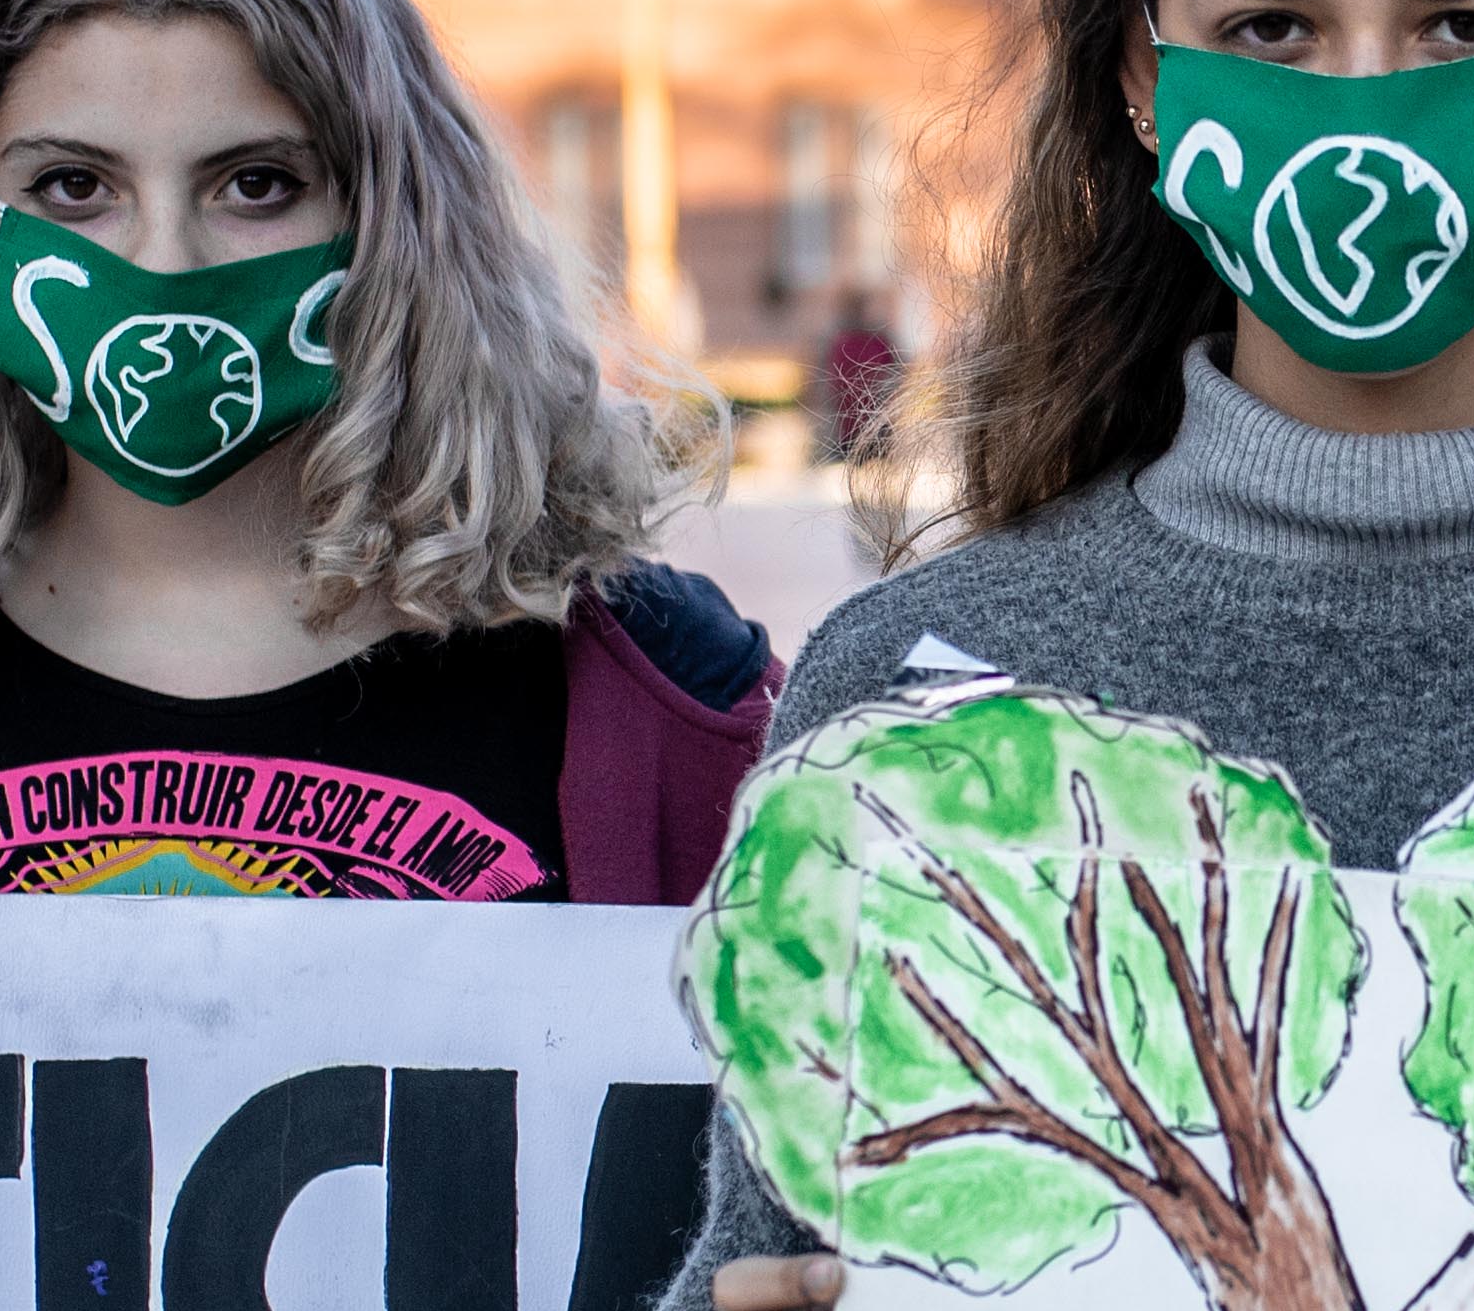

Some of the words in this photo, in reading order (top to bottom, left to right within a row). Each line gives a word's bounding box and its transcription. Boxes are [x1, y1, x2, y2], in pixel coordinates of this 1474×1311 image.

[20, 760, 256, 836] CONSTRUIR
[253, 770, 386, 850] DESDE
[361, 795, 422, 860] EL
[397, 810, 507, 898] AMOR
